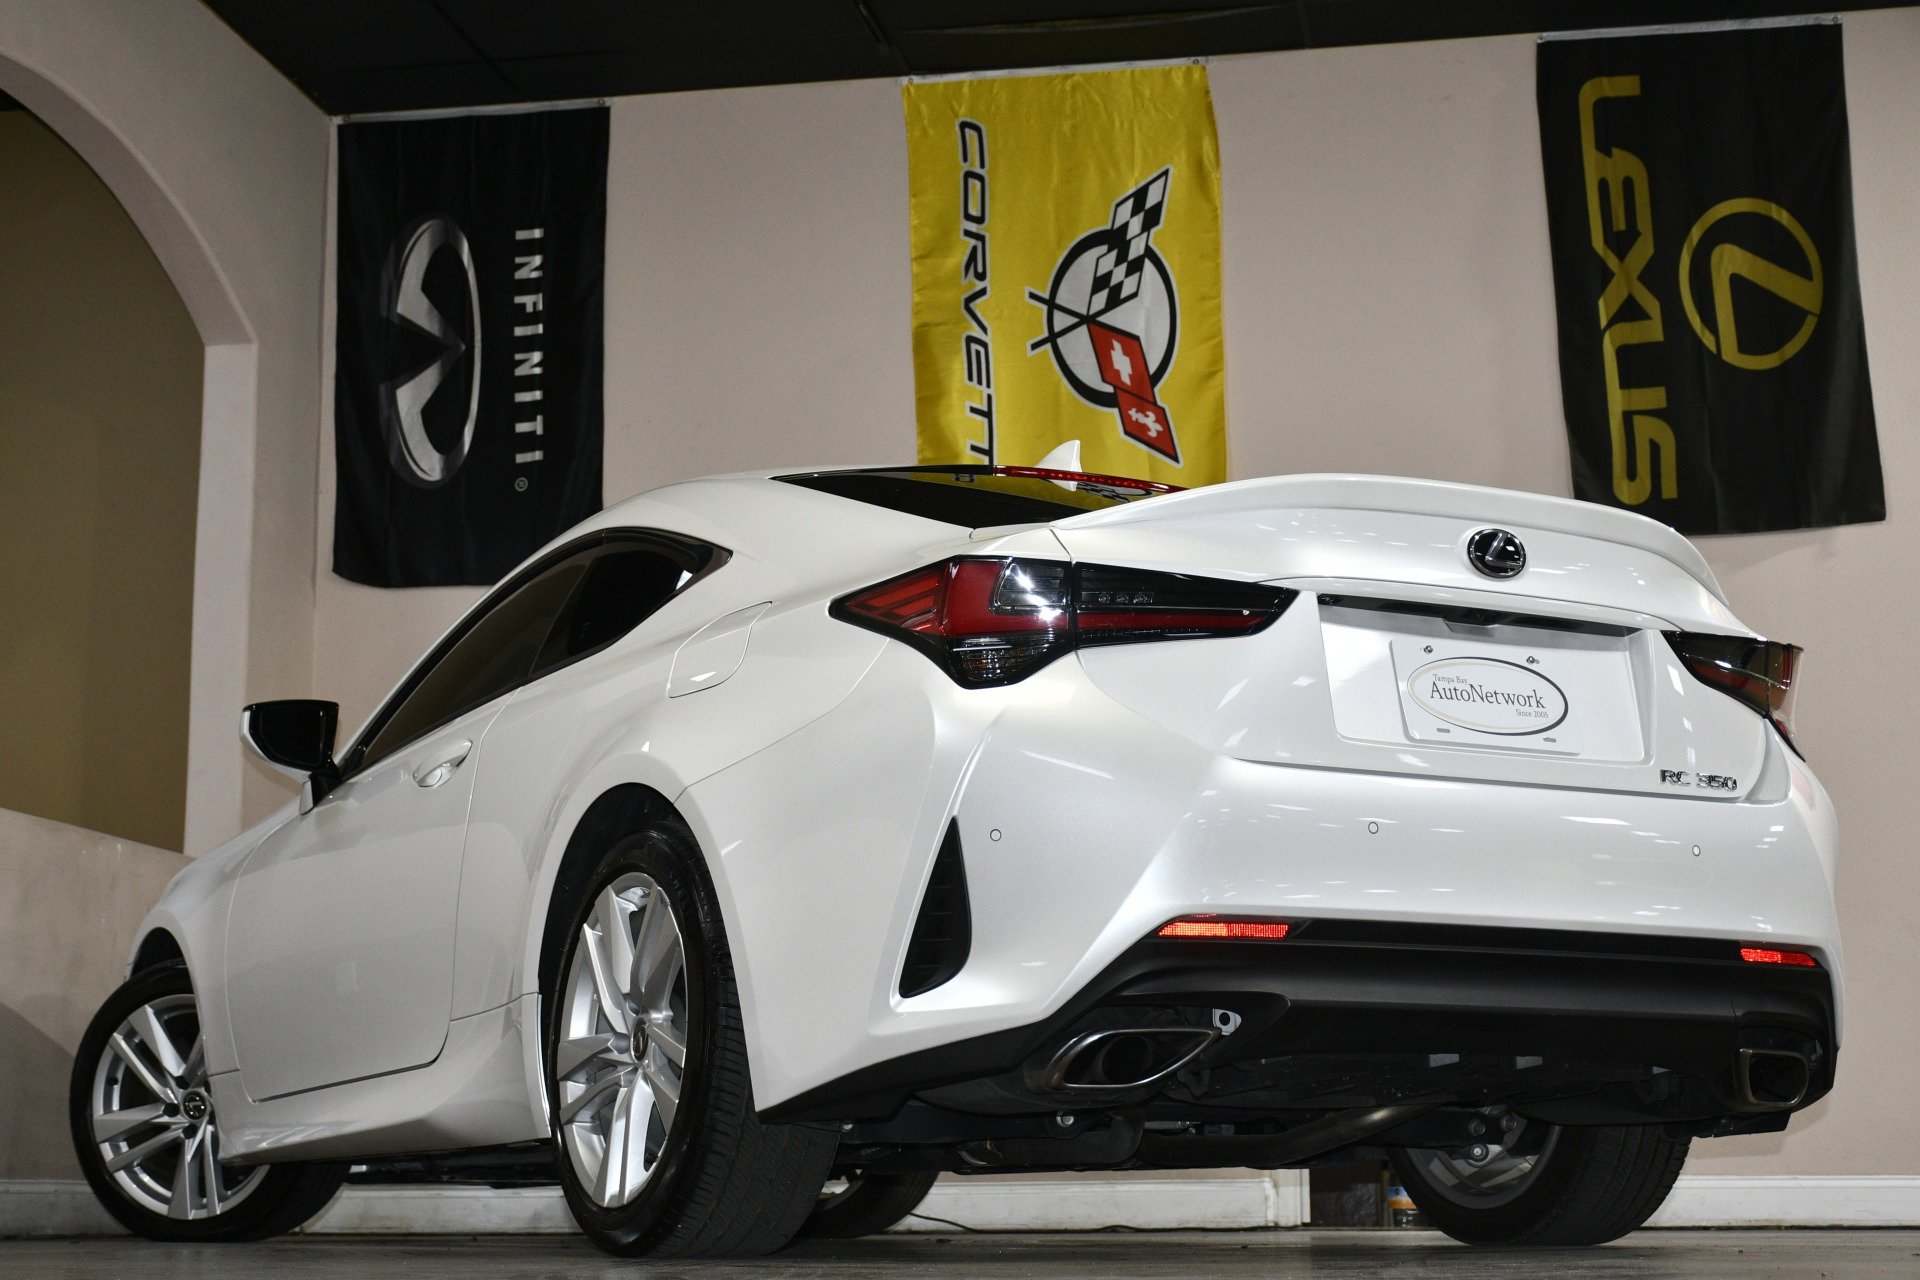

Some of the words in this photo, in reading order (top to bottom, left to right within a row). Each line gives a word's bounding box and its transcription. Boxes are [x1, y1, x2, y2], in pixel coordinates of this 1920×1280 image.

[1578, 75, 1678, 506] LEXUS
[514, 228, 544, 463] INFINITI
[1432, 673, 1455, 685] Tampa
[1455, 675, 1468, 686] Bay
[1430, 681, 1546, 709] AutoNetwork
[1515, 708, 1532, 718] Since
[1533, 710, 1549, 719] 2005
[1660, 769, 1691, 786] RC
[1696, 772, 1738, 791] 350
